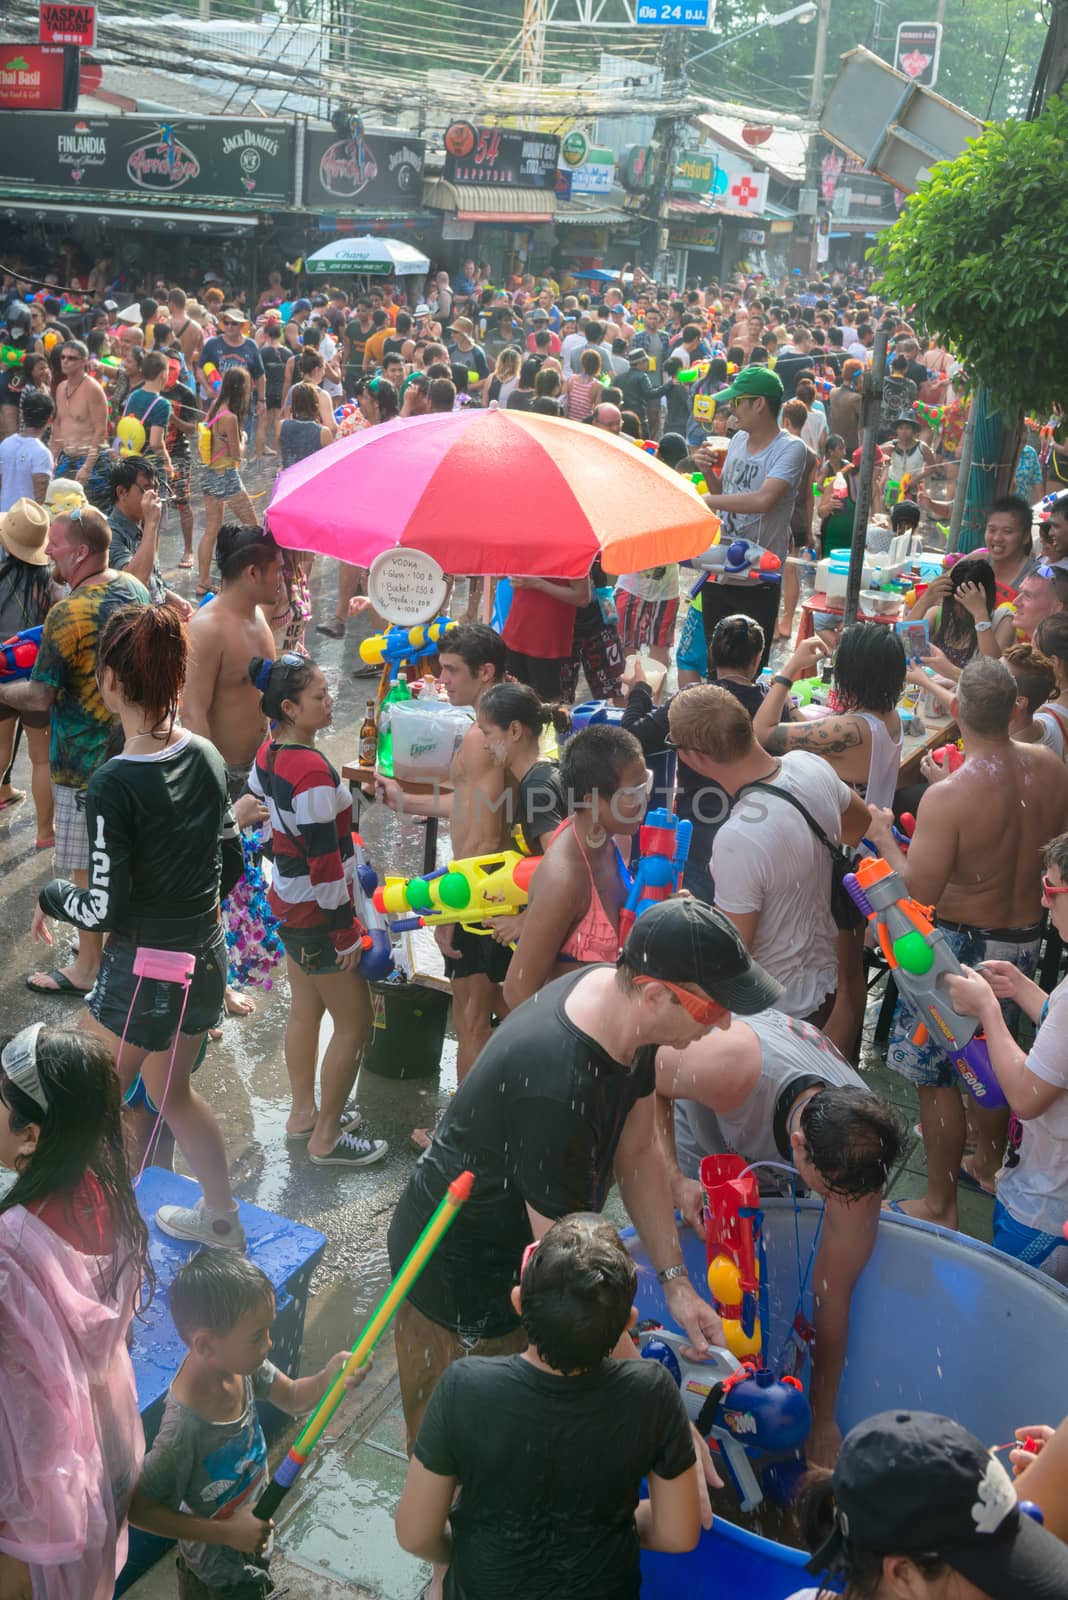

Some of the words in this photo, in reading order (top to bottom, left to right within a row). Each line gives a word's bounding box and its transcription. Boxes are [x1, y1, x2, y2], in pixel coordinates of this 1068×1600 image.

[43, 7, 92, 25] JASPAL
[661, 4, 682, 20] 24
[47, 21, 88, 33] TAILORS
[18, 70, 41, 86] Basil
[58, 135, 106, 155] FINLANDIA
[222, 134, 245, 154] JACK
[243, 129, 279, 156] DANIEL'S
[474, 130, 501, 166] 54
[521, 140, 545, 159] MOUNT
[336, 248, 370, 260] Chang
[391, 558, 418, 569] VODKA
[412, 571, 425, 581] 100
[961, 1071, 986, 1097] 5000
